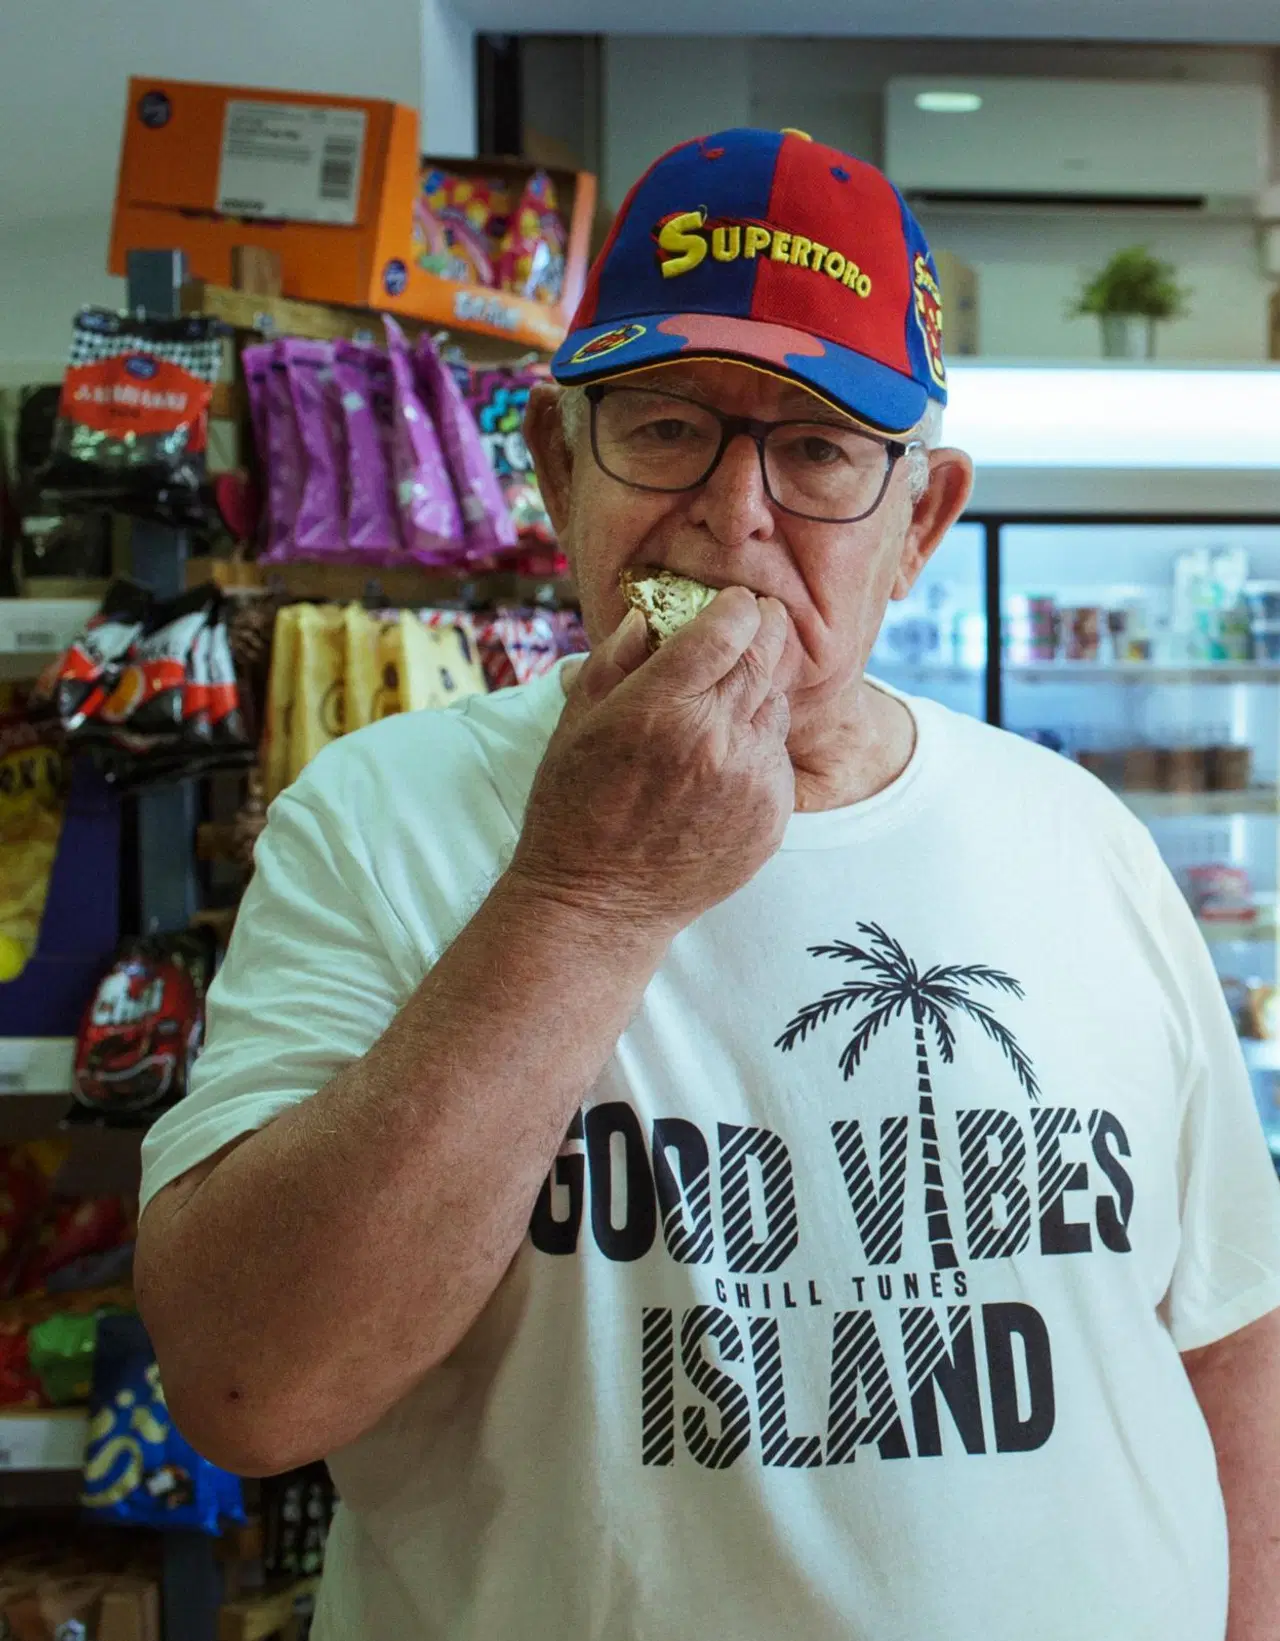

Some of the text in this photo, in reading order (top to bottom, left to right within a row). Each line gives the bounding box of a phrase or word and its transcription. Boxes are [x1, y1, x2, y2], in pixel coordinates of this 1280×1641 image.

[657, 209, 873, 299] SUPERTORO
[715, 1269, 968, 1310] CHILL TUNES
[642, 1301, 1057, 1470] ISLAND
